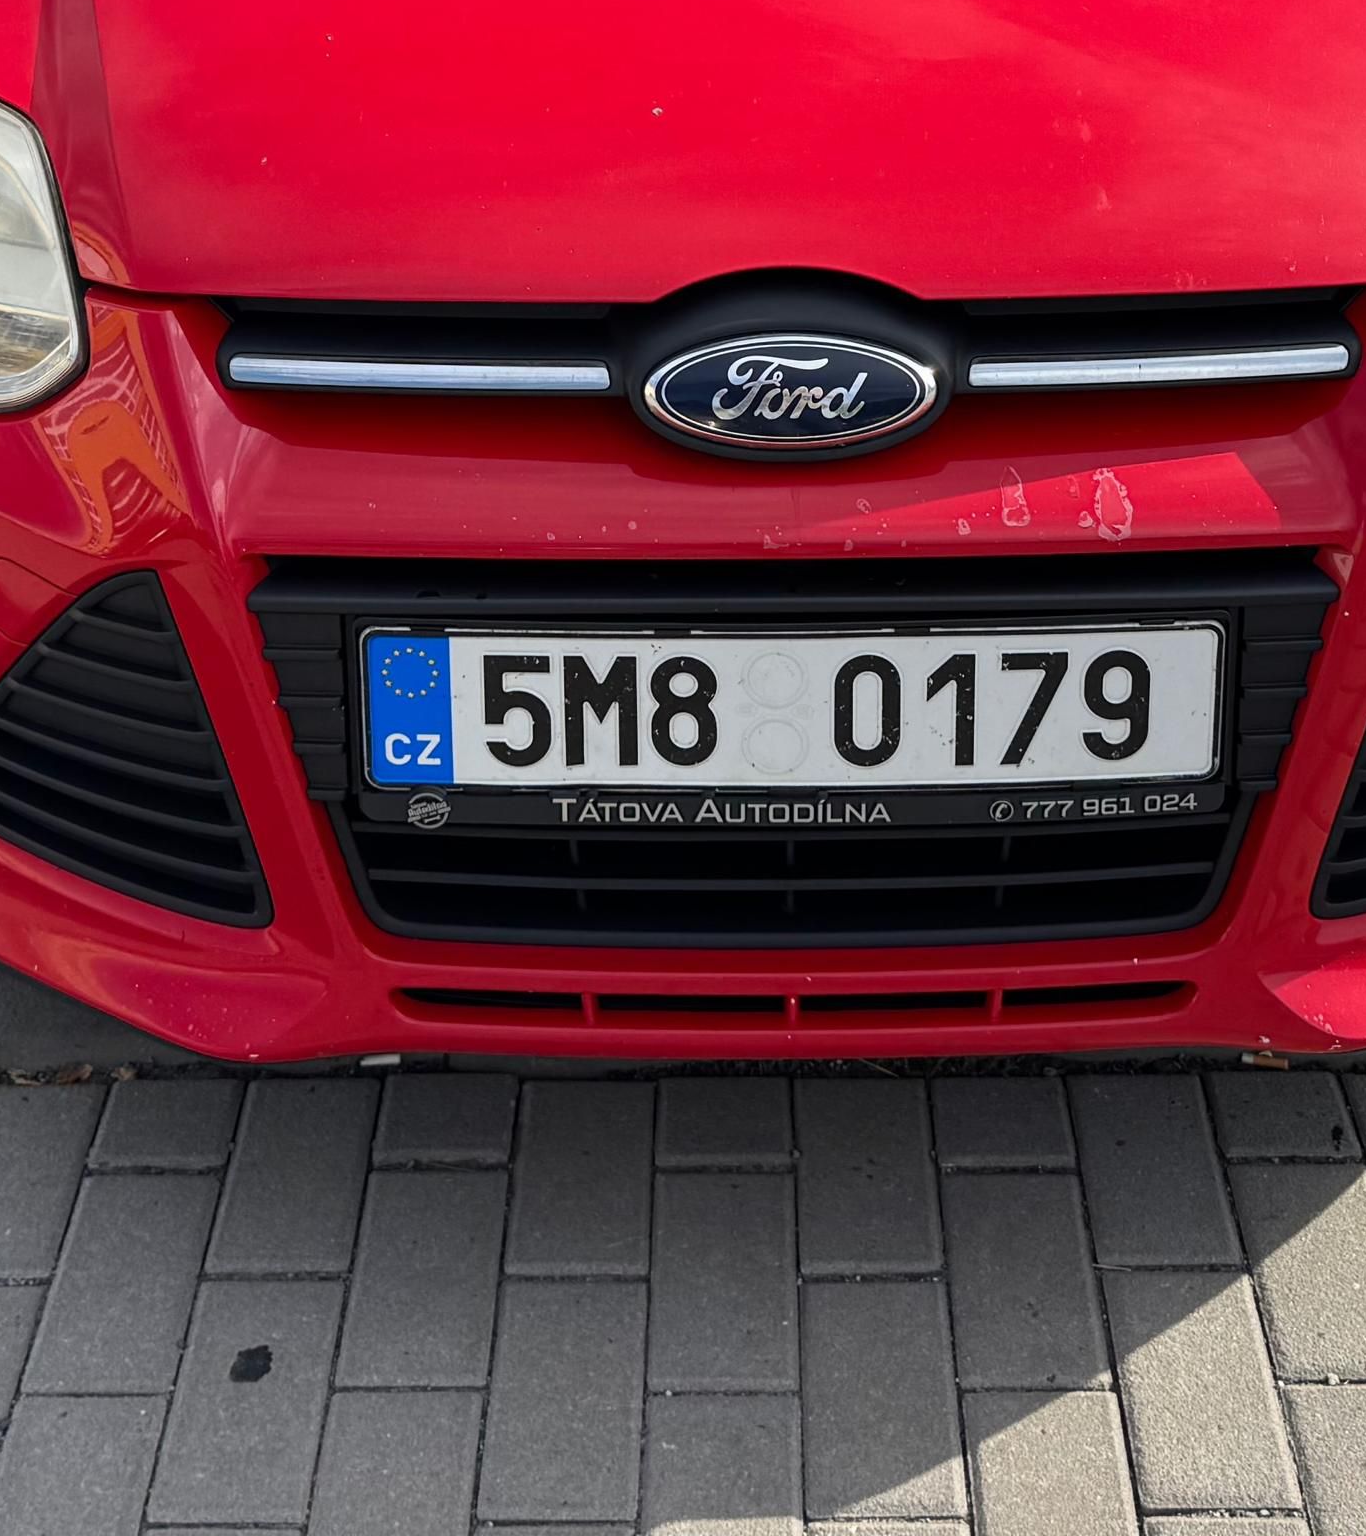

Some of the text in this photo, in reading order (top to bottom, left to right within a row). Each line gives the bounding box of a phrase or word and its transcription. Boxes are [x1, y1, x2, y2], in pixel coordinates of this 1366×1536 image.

[712, 355, 868, 420] Ford
[483, 649, 1151, 767] 5M8 0179
[384, 733, 441, 765] CZ
[552, 798, 892, 823] TÁTOVA AUTODÍLNA
[1022, 792, 1198, 819] 777 961 024
